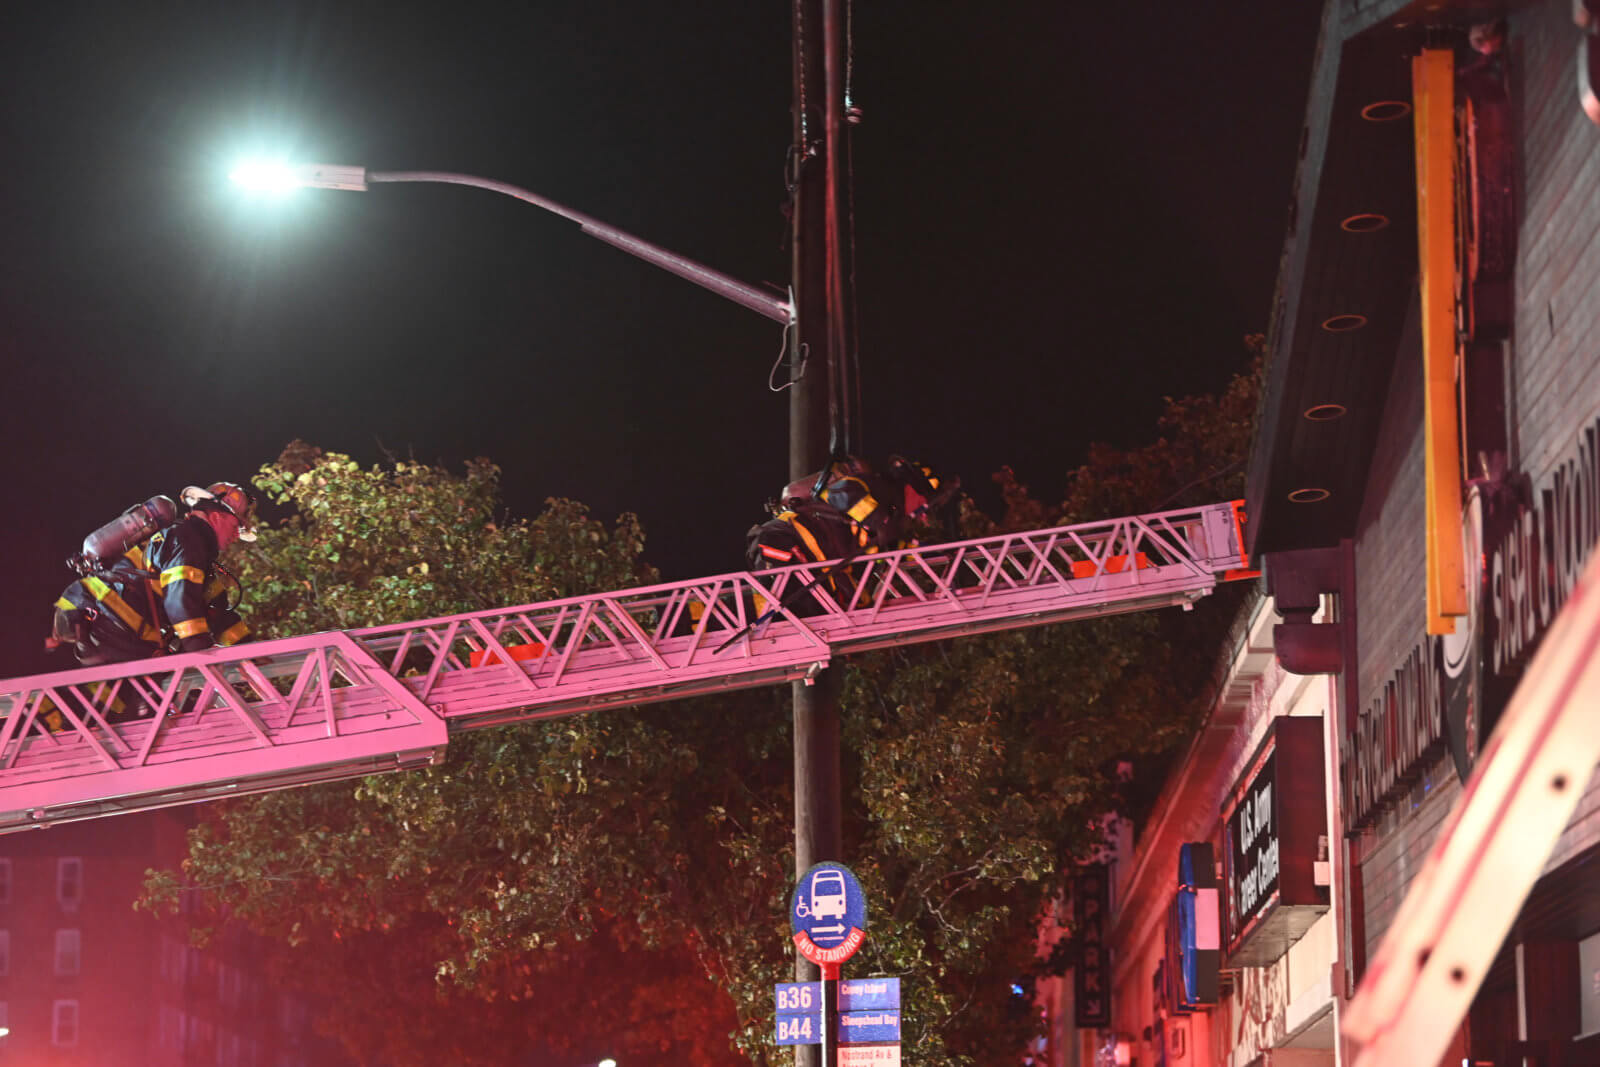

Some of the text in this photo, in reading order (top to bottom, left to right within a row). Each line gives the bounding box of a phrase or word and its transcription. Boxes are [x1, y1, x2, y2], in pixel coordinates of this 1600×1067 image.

[799, 932, 861, 962] NO STANDING
[778, 986, 813, 1009] B36
[778, 1016, 813, 1041] B44
